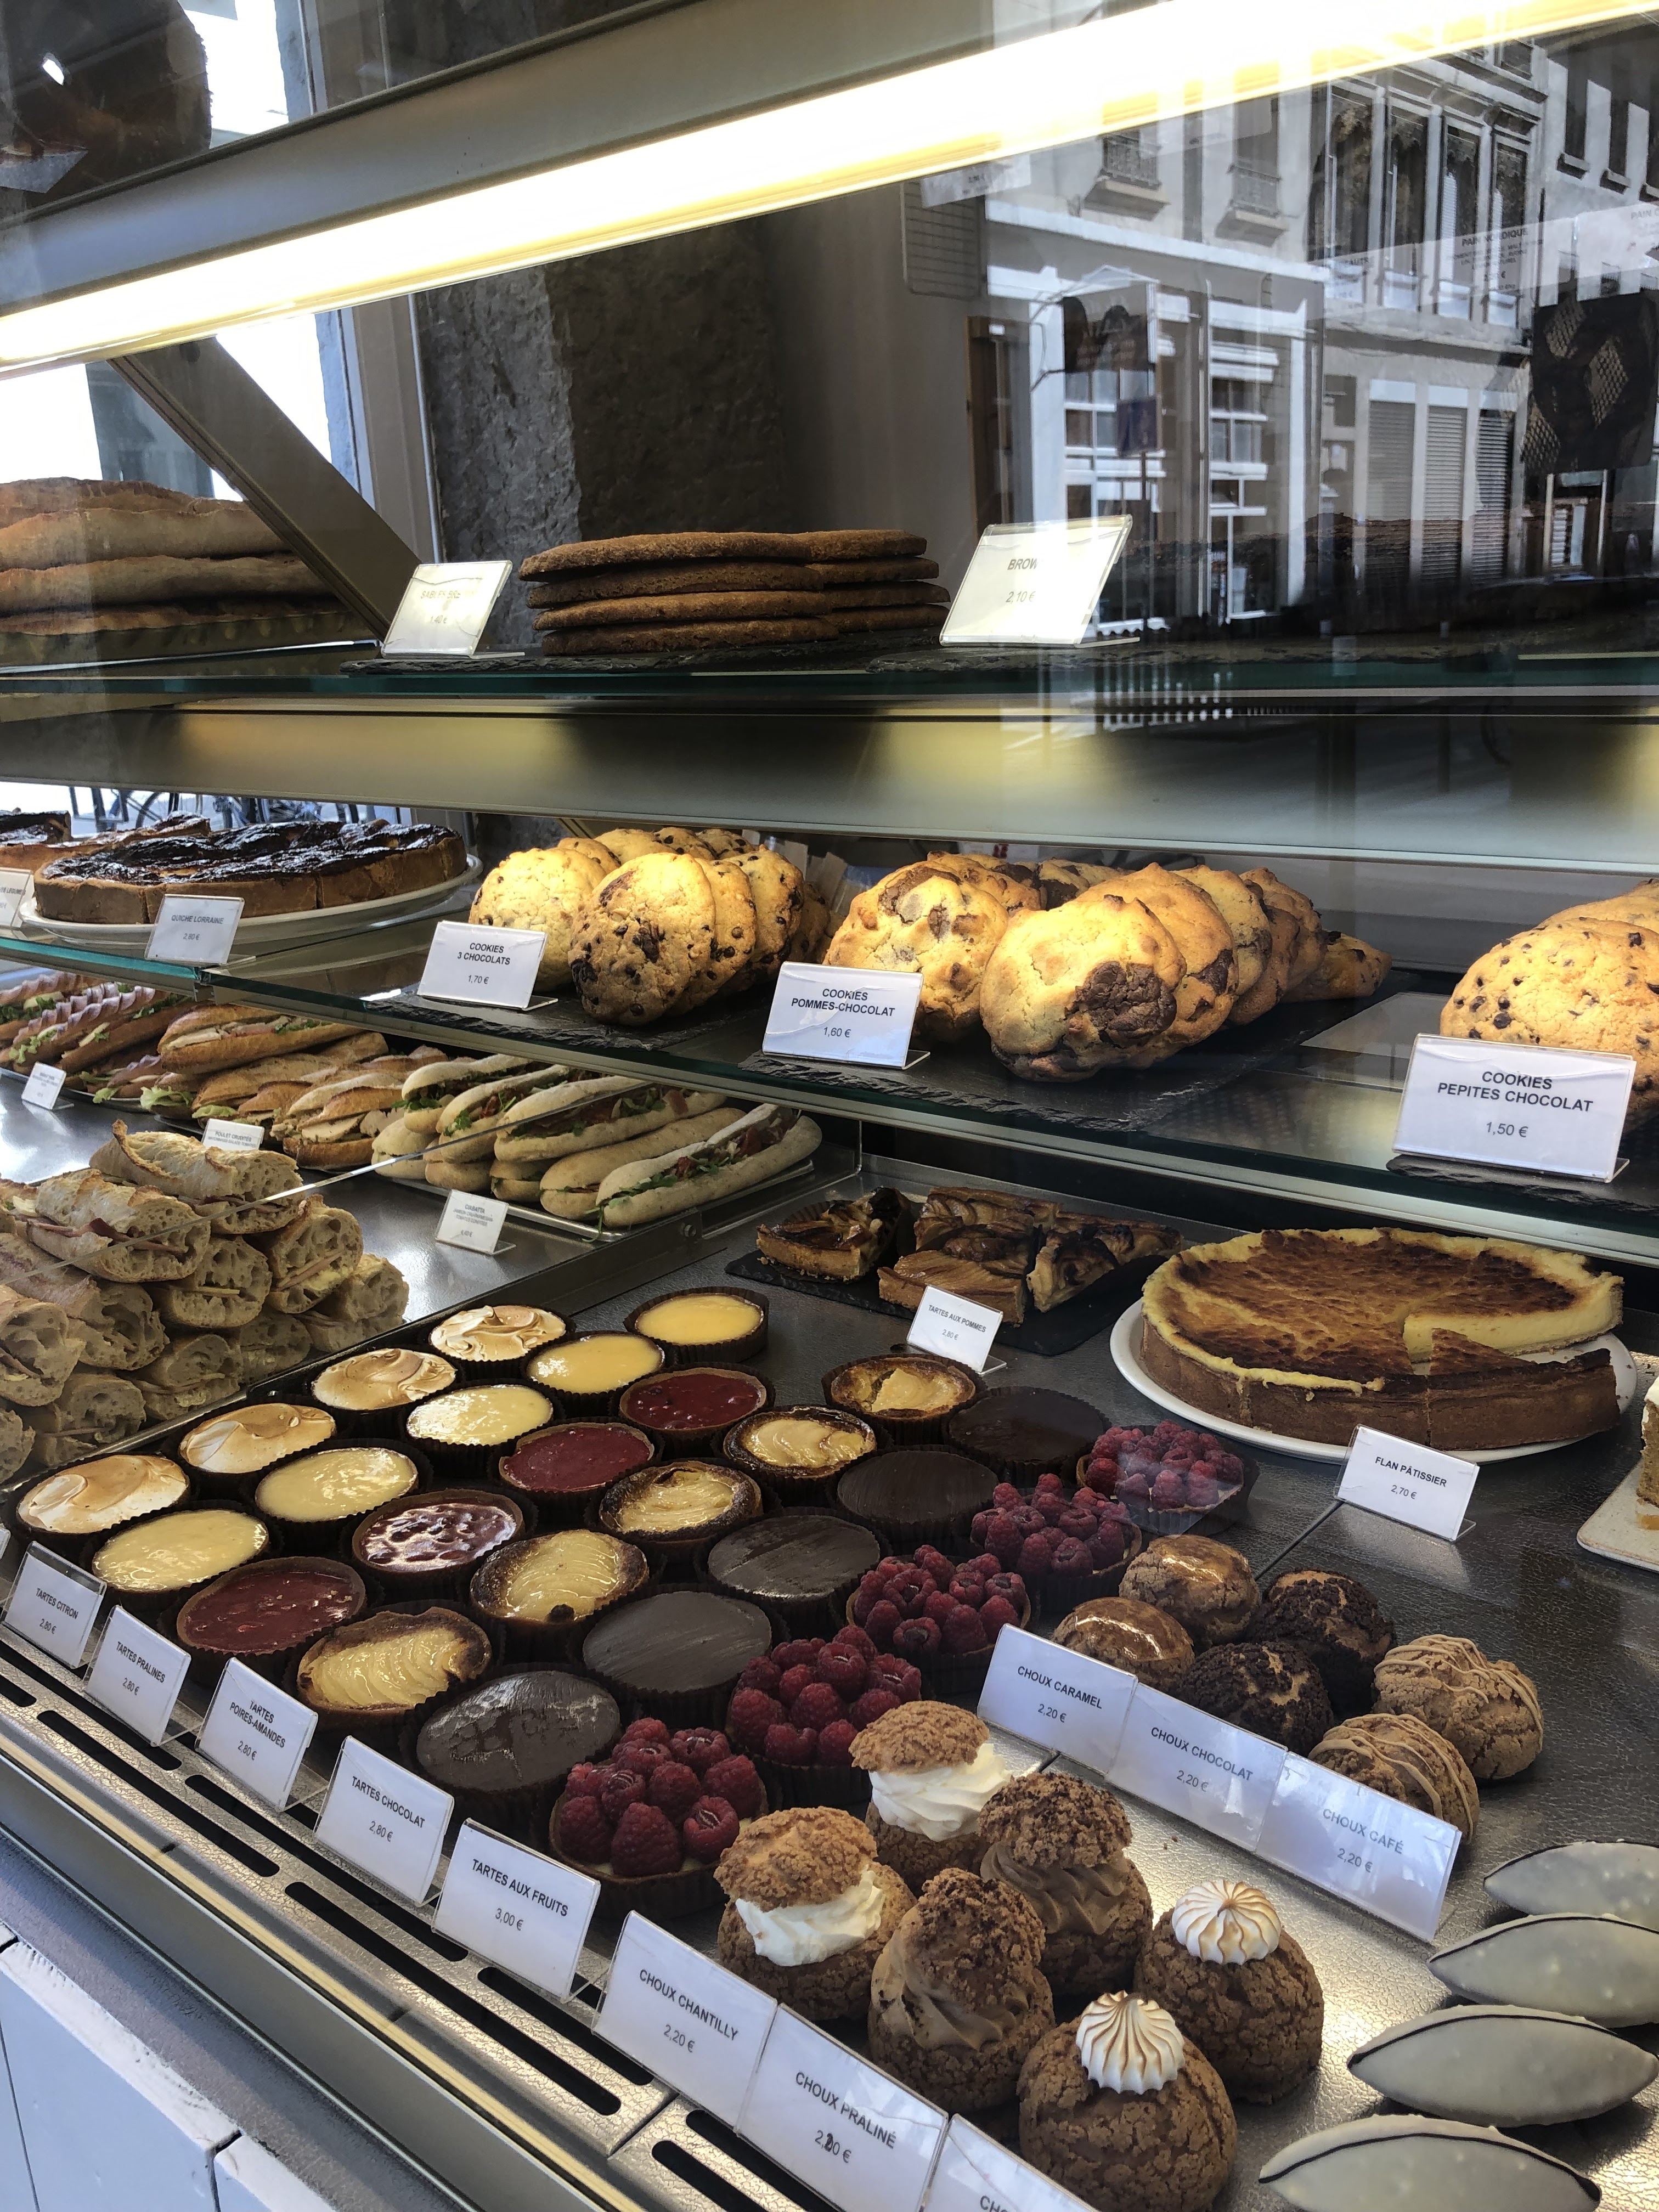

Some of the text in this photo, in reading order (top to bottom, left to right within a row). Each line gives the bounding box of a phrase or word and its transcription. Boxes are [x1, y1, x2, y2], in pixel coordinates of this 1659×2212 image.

[1006, 591, 1036, 604] 2,10 €
[194, 916, 224, 924] LORRAINE
[464, 952, 510, 965] CHOCOLATS
[470, 943, 504, 953] COOKIES
[468, 975, 483, 984] 1,70
[822, 989, 868, 1001] COOKIES
[792, 998, 895, 1017] POMMES-CHOCOLAT
[823, 1027, 851, 1038] 1,60 €
[1482, 1071, 1553, 1090] COOKIES
[1437, 1082, 1593, 1112] PEPITES CHOCOLAT
[1486, 1122, 1528, 1138] 1,50 €
[928, 1305, 986, 1333] TARTES AUX POMMES
[942, 1329, 953, 1339] 2,80
[1375, 1457, 1447, 1487] FLAN PÂTISSIER
[1391, 1485, 1417, 1499] 2,70 €
[36, 1588, 78, 1620] TARTES CITRON
[40, 1618, 57, 1634] 2,80 €
[116, 1641, 166, 1683] TARTES PRALINES
[122, 1678, 140, 1695] 2,80 €
[1018, 1666, 1103, 1709] CHOUX CARAMEL
[250, 1700, 274, 1724] TARTES
[1037, 1704, 1067, 1723] 2,20 €
[230, 1702, 286, 1748] POIRES-AMANDES
[238, 1740, 257, 1760] 2,80 €
[1151, 1727, 1253, 1781] CHOUX CHOCOLAT
[1176, 1770, 1209, 1792] 2,20 €
[352, 1776, 425, 1829] TARTES CHOCOLAT
[369, 1820, 393, 1842] 2,80 €
[1323, 1809, 1404, 1854] CHOUX CAFÉ
[1338, 1848, 1373, 1872] 2,20 €
[472, 1859, 568, 1917] TARTES AUX FRUITS
[495, 1908, 524, 1931] 3,00 €
[639, 1969, 739, 2041] CHOUX CHANTILLY
[663, 2024, 695, 2053] 2,20 €
[795, 2072, 897, 2149] CHOUX PRALINÉ
[842, 2149, 852, 2163] €
